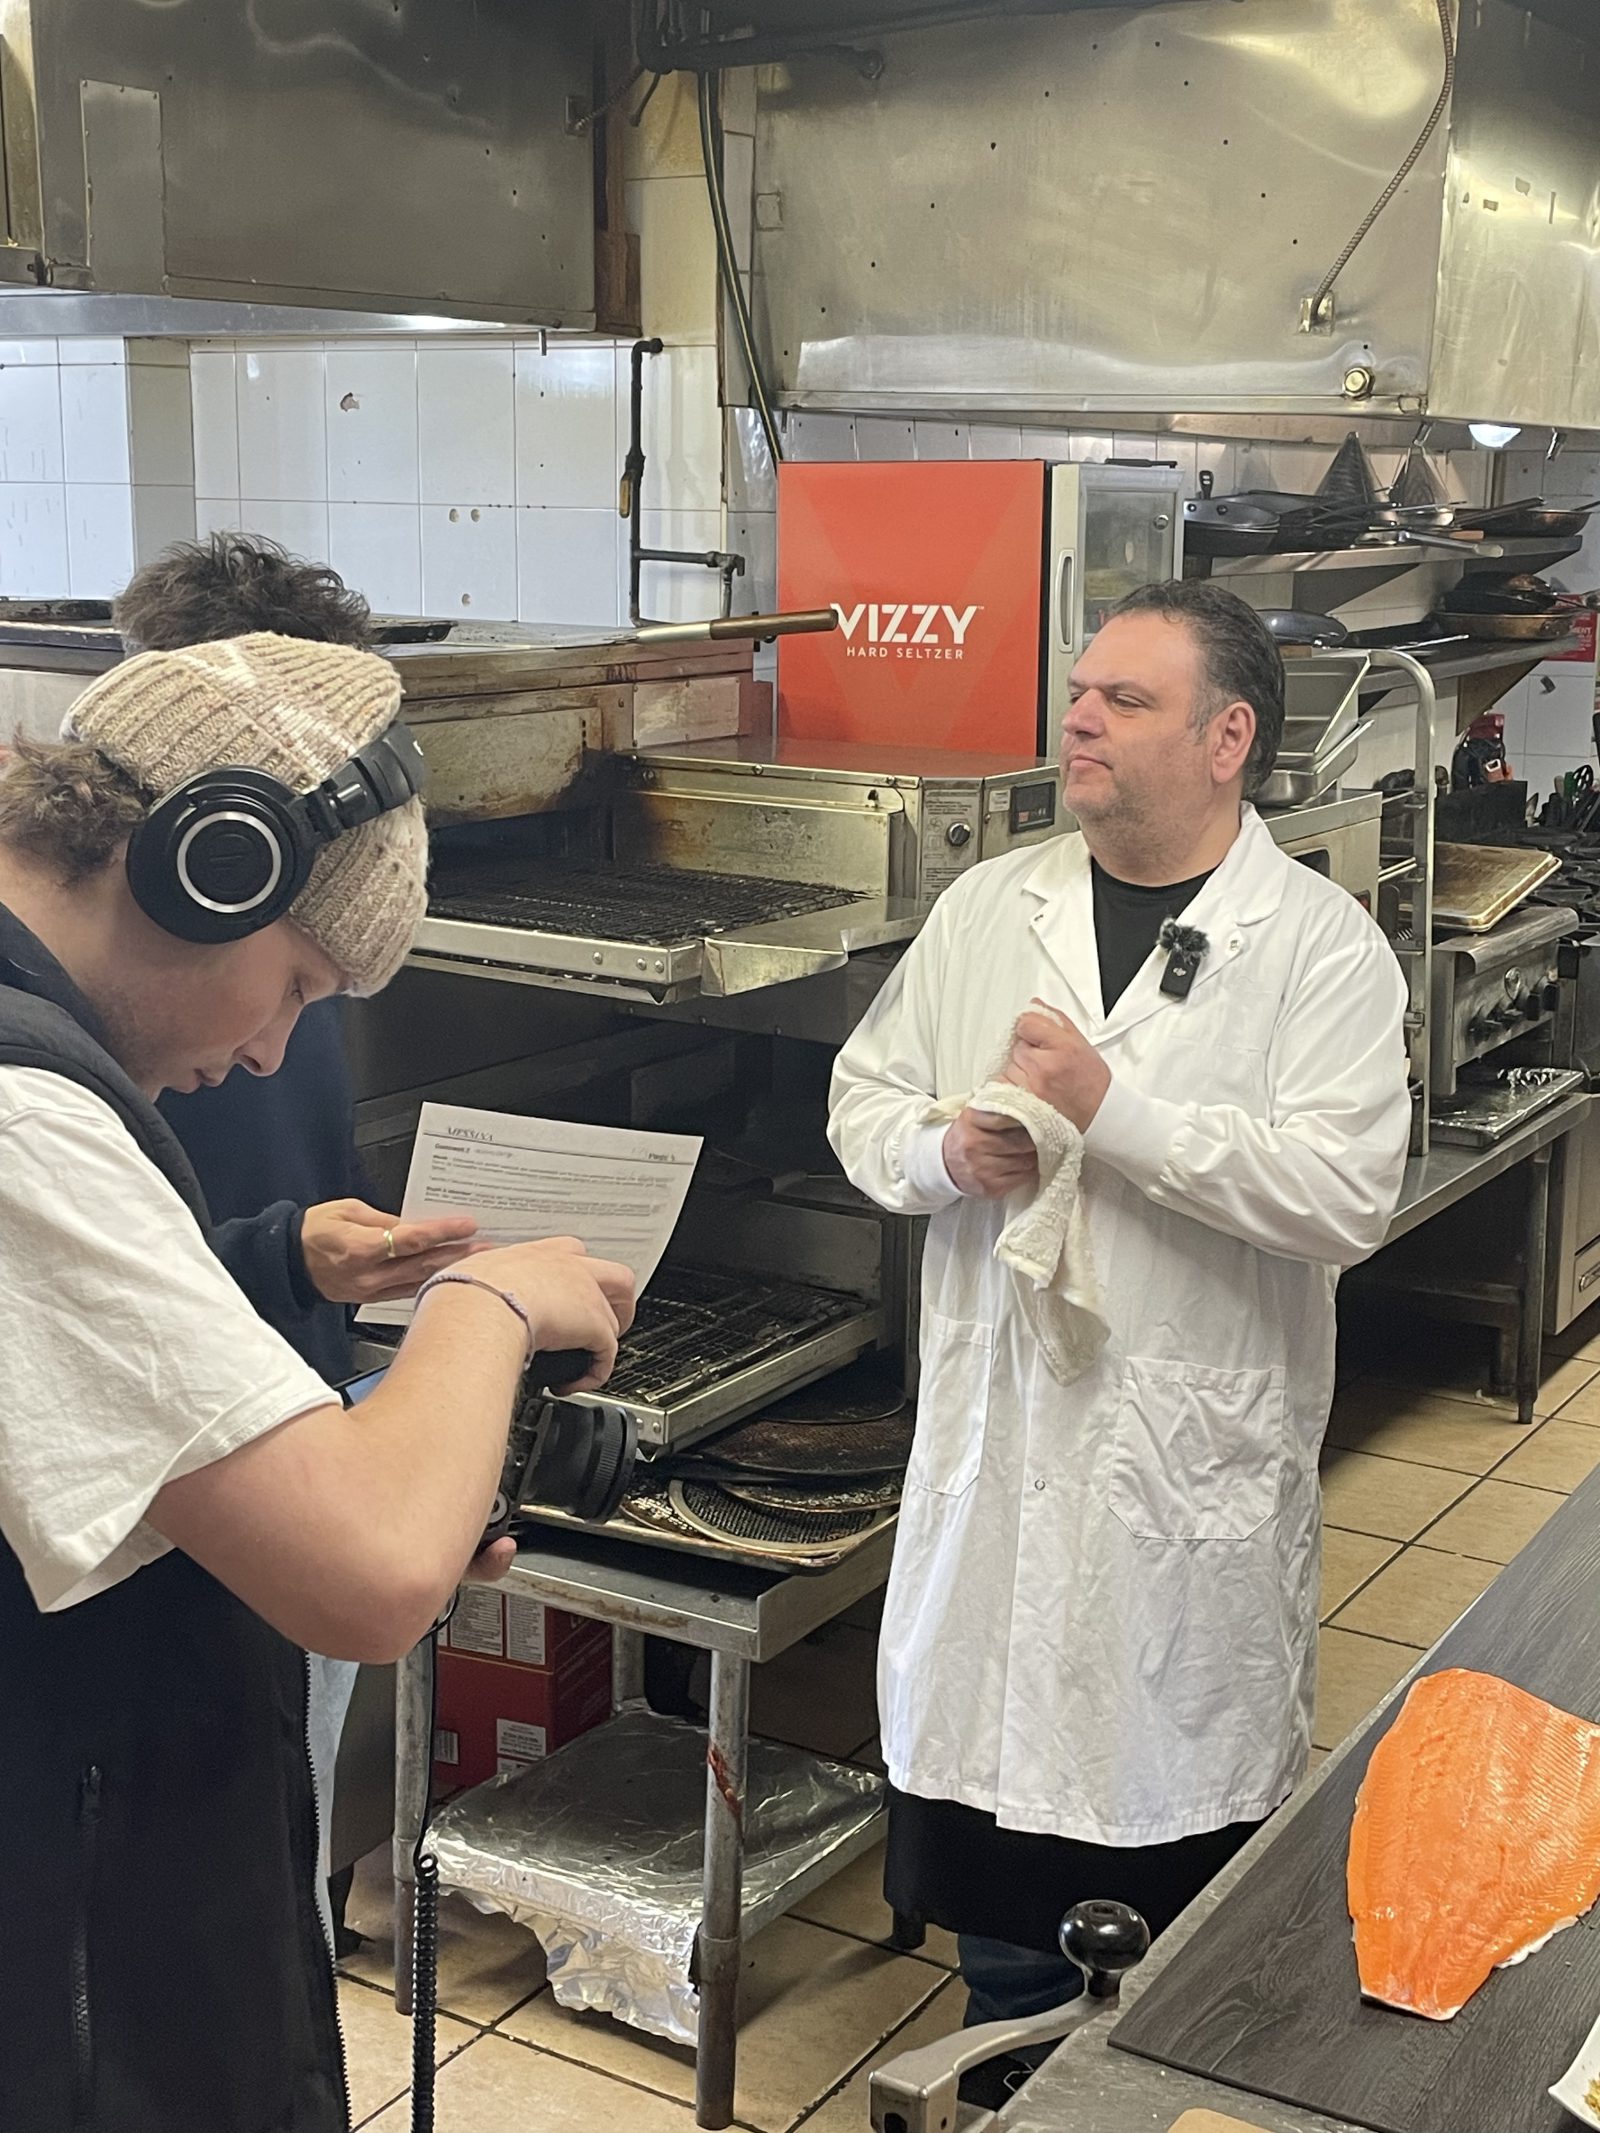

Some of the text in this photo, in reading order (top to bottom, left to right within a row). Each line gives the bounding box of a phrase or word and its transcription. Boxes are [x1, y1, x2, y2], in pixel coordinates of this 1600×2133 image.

[830, 603, 977, 645] VIZZY
[846, 647, 964, 660] HARD SELTZER
